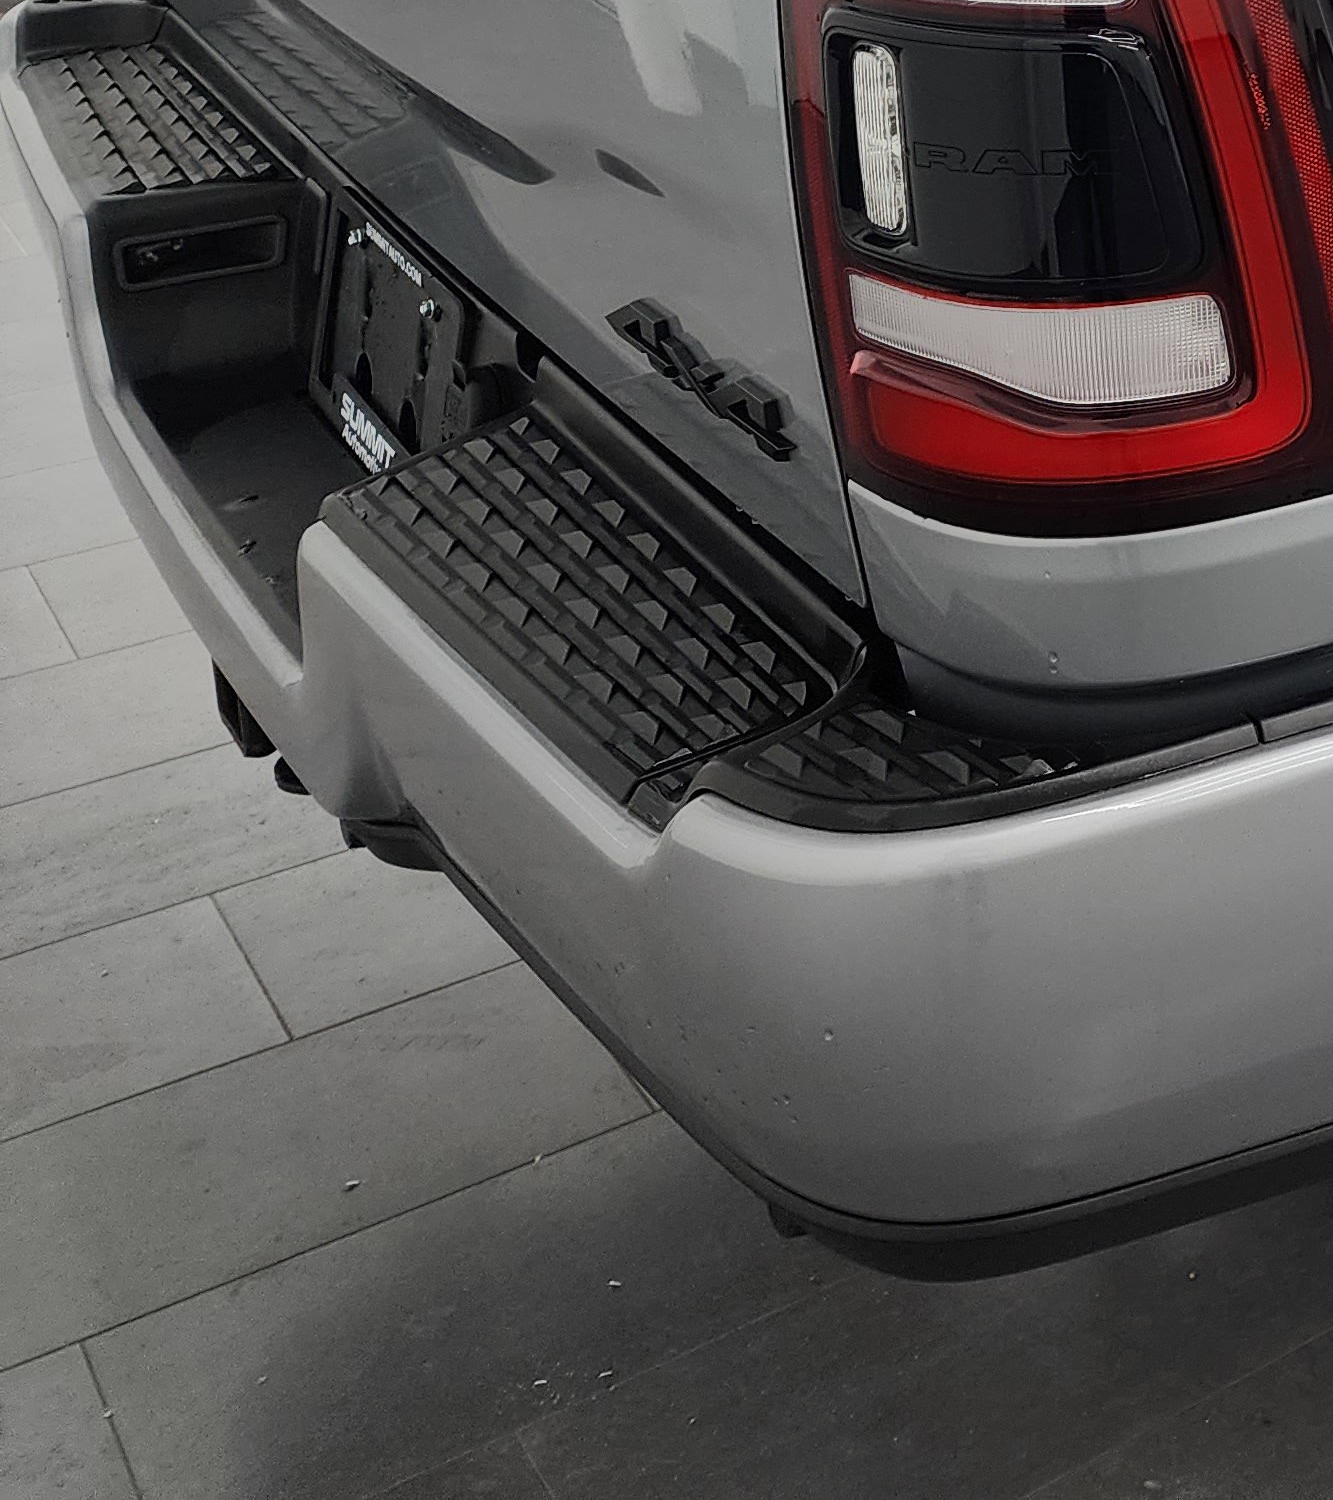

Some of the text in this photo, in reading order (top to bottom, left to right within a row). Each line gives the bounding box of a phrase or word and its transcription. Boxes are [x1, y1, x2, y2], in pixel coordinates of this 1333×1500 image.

[913, 141, 1113, 177] RAM
[341, 392, 396, 469] SUMMIT
[342, 423, 382, 475] Automotiv
